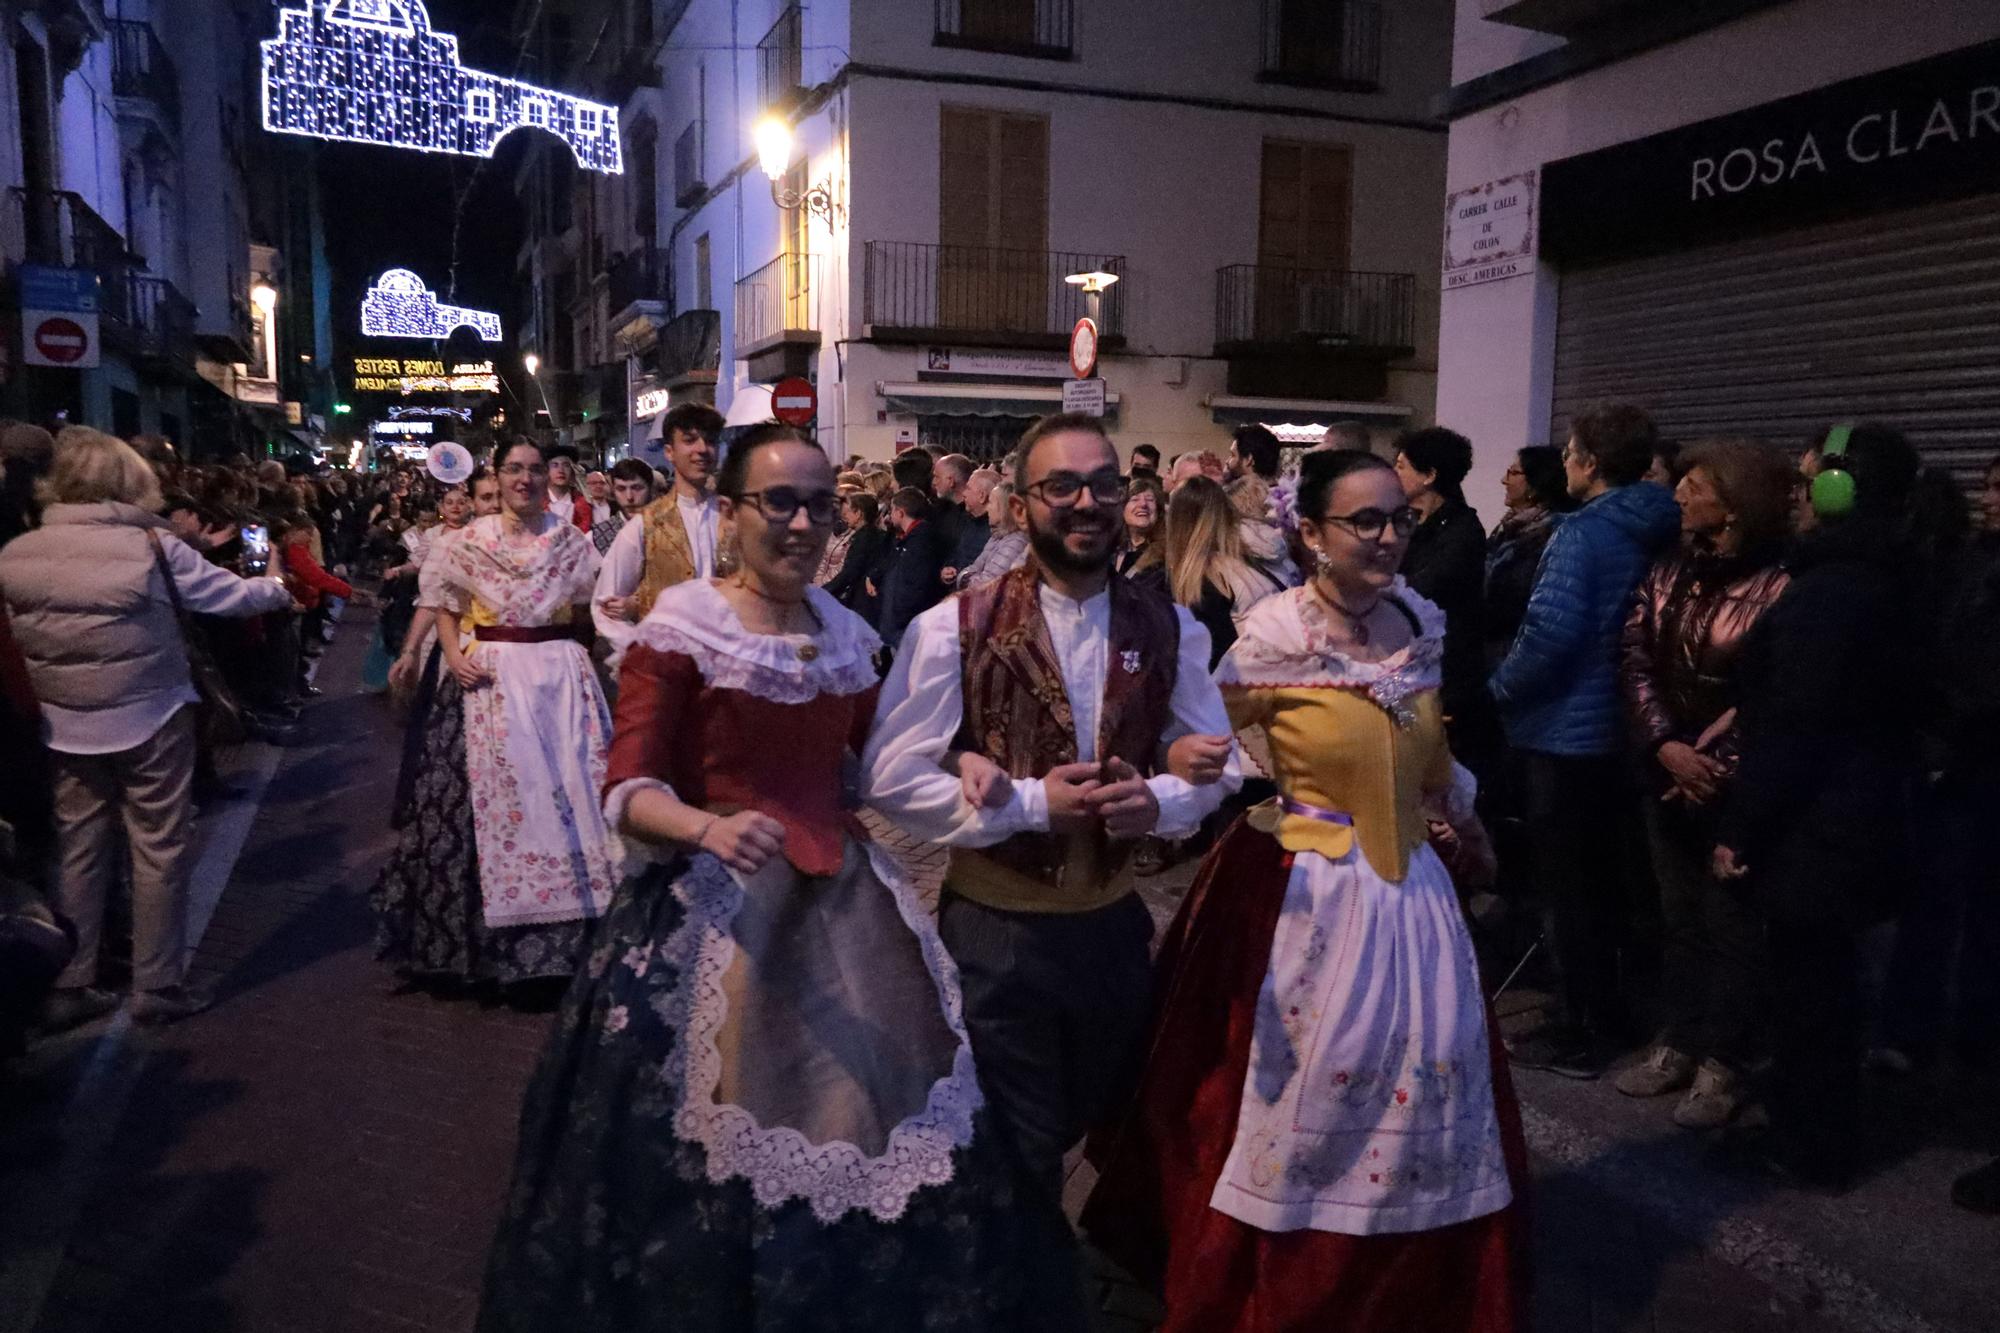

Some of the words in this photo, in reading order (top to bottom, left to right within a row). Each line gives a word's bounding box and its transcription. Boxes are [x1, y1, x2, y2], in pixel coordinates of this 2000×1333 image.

[1691, 131, 1826, 201] ROSA
[1846, 85, 2000, 164] CLAR
[1459, 203, 1488, 219] CARRER
[1494, 195, 1517, 211] CALLE
[1482, 221, 1493, 233] DE
